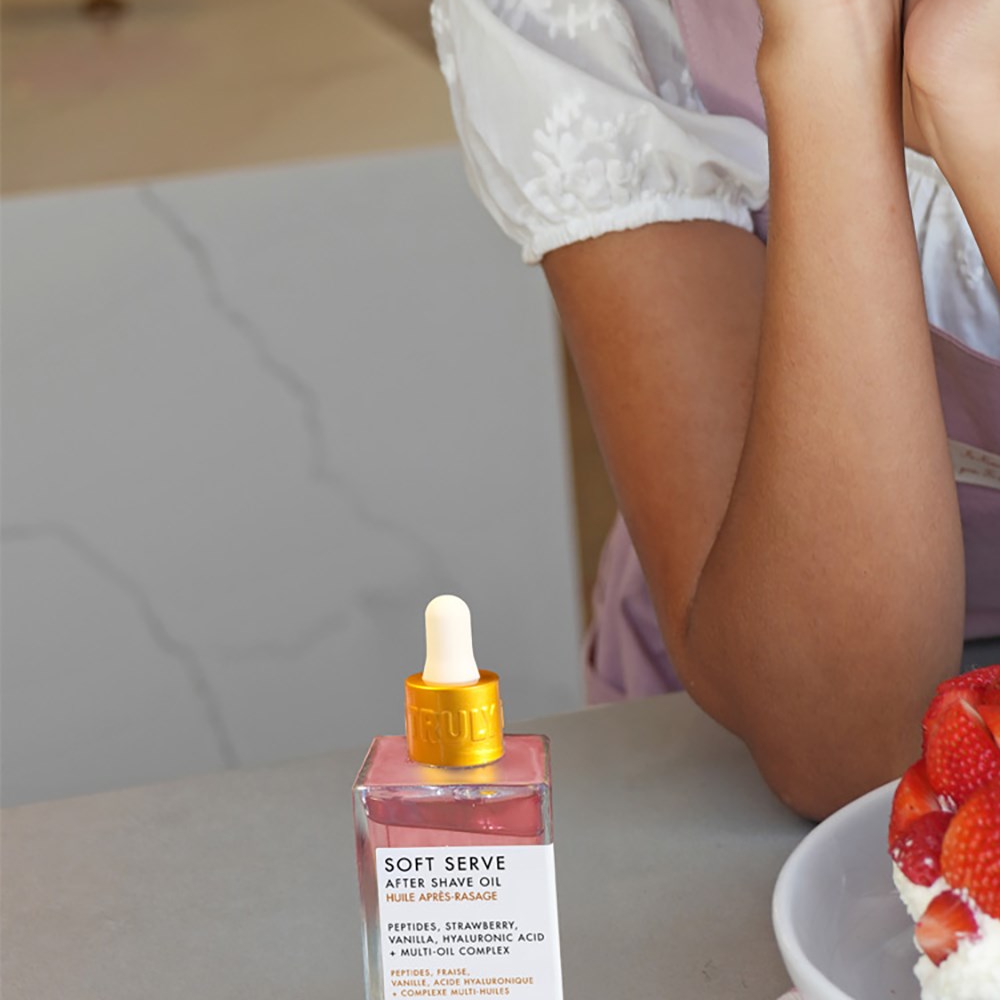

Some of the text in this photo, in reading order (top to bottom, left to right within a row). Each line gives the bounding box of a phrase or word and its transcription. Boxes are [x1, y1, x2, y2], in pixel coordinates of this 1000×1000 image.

[385, 856, 505, 872] SOFT SERVE
[385, 877, 501, 888] AFTER SHAVE OIL
[386, 891, 498, 902] HUILE APRÈS-RASAGE
[388, 921, 518, 932] PEPTIDES, STRAWBERRY,
[388, 933, 545, 944] VANILLA, HYALURONIC ACID
[400, 948, 455, 956] MULTI-OIL
[459, 946, 510, 956] COMPLEX
[390, 969, 434, 977] PEPTIDES,
[464, 977, 534, 985] HYALURONIQUE
[400, 989, 447, 997] COMPLEXE
[450, 988, 510, 996] MULTI-HUILES
